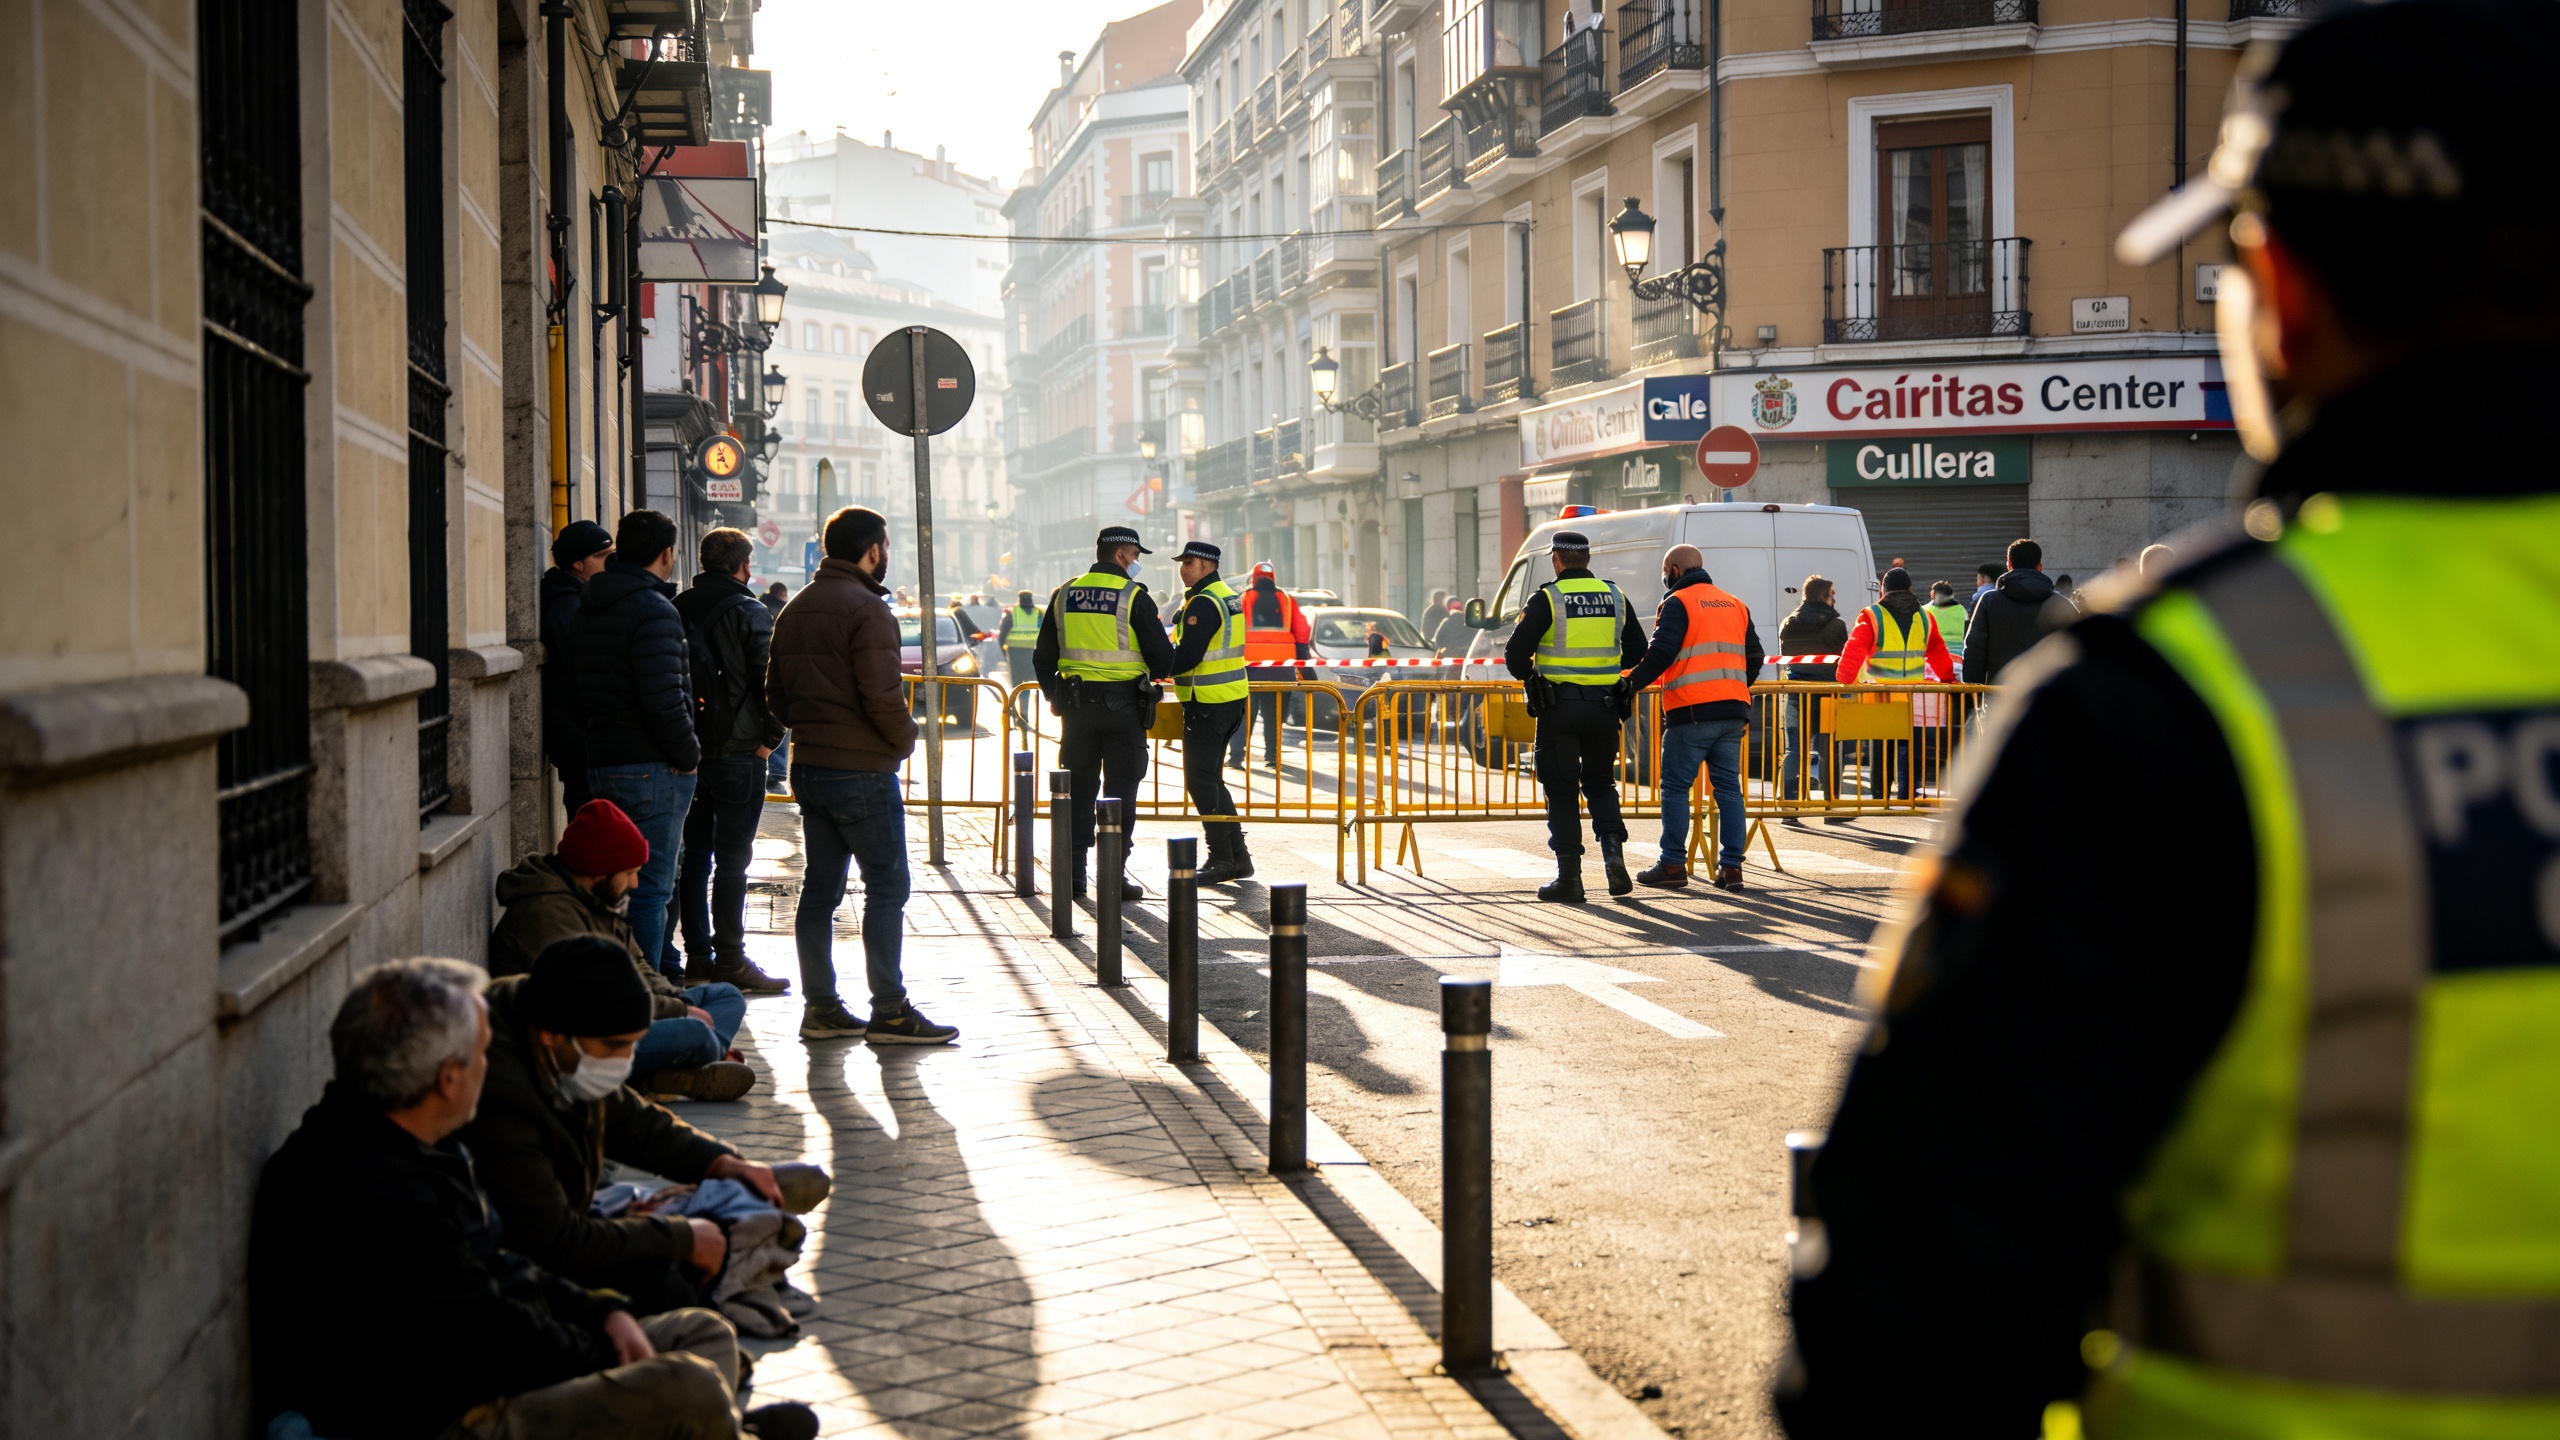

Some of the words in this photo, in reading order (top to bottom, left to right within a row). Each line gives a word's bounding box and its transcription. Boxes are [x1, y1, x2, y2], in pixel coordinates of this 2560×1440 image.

[1648, 392, 1708, 421] Calle
[1826, 373, 2024, 421] Caíritas
[2041, 374, 2185, 412] Center
[1856, 442, 1996, 480] Cullera
